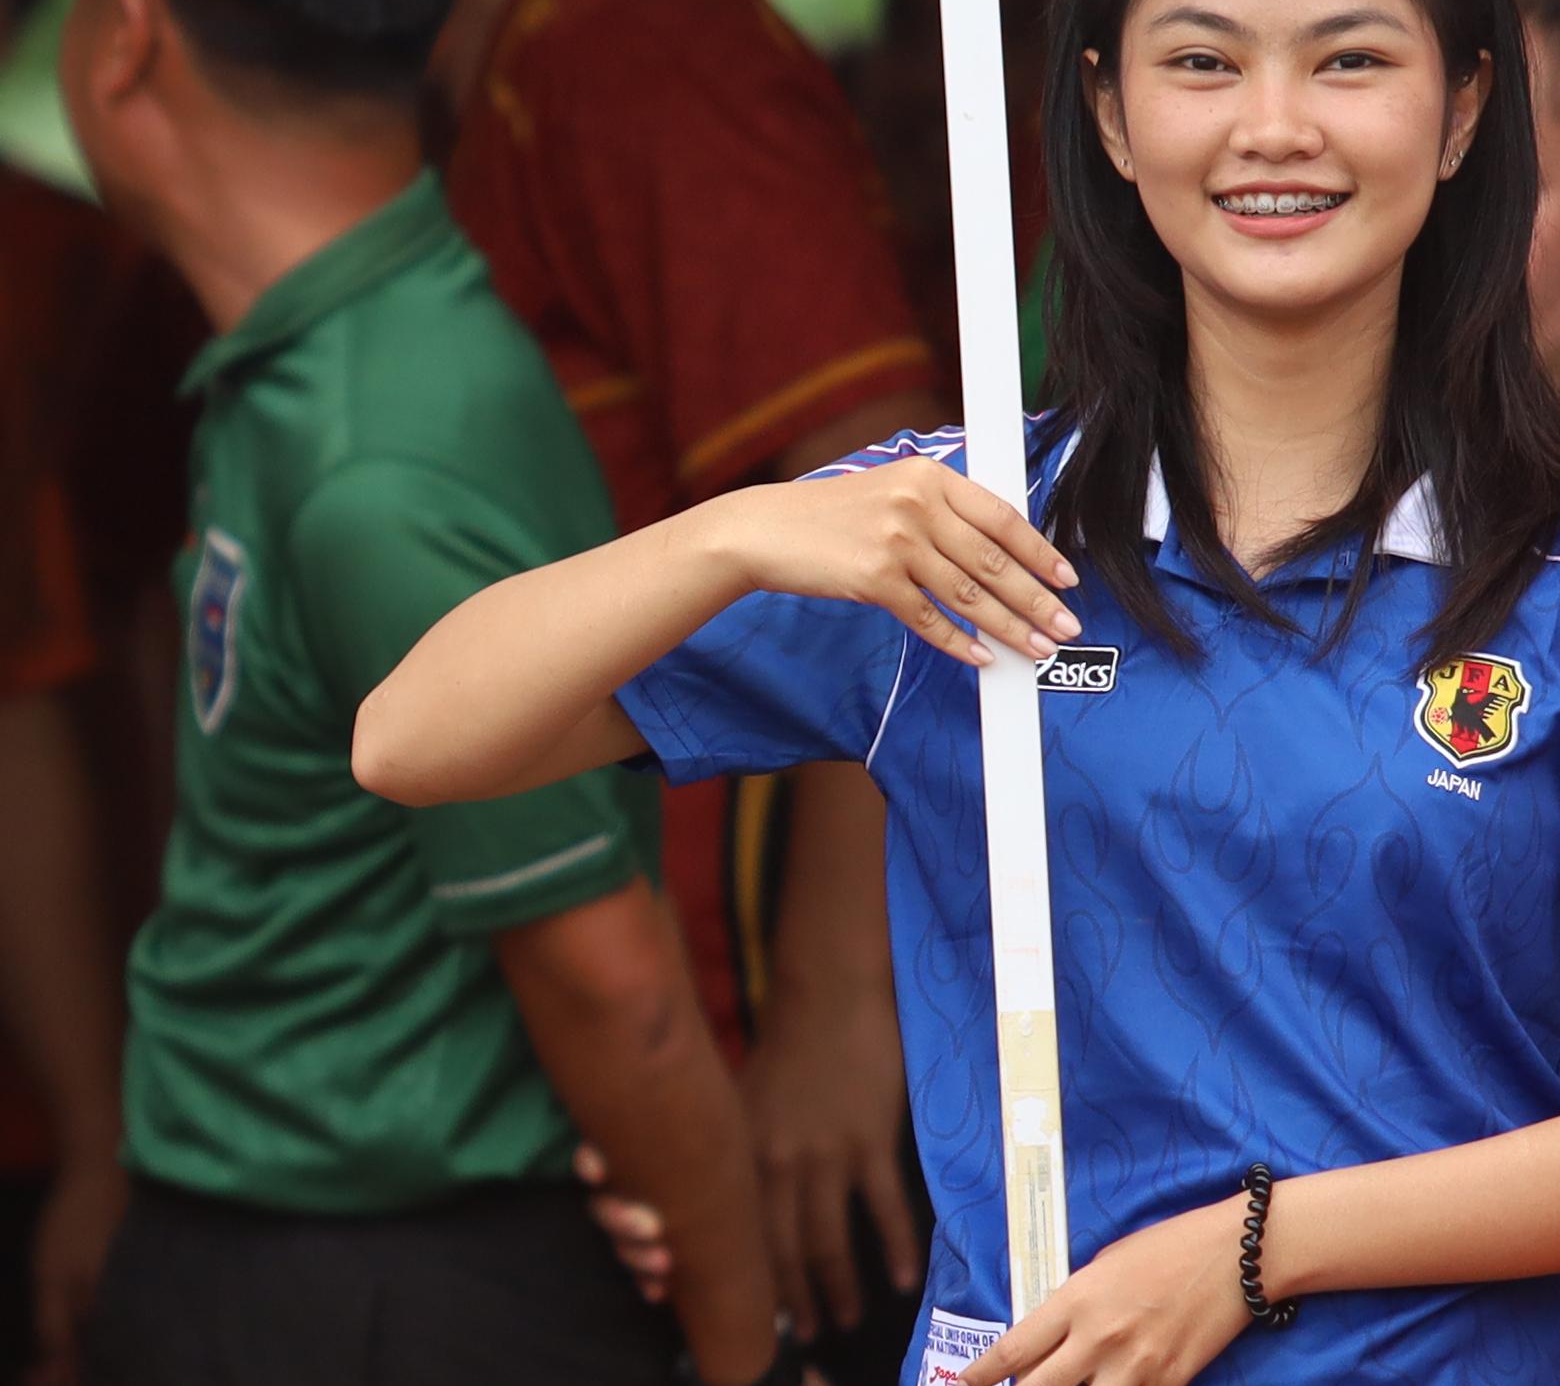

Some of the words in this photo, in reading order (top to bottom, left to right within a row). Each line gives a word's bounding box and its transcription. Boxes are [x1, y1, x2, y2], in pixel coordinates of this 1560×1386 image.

[1439, 663, 1511, 692] JFA
[1427, 768, 1483, 801] JAPAN
[982, 1334, 996, 1348] OF
